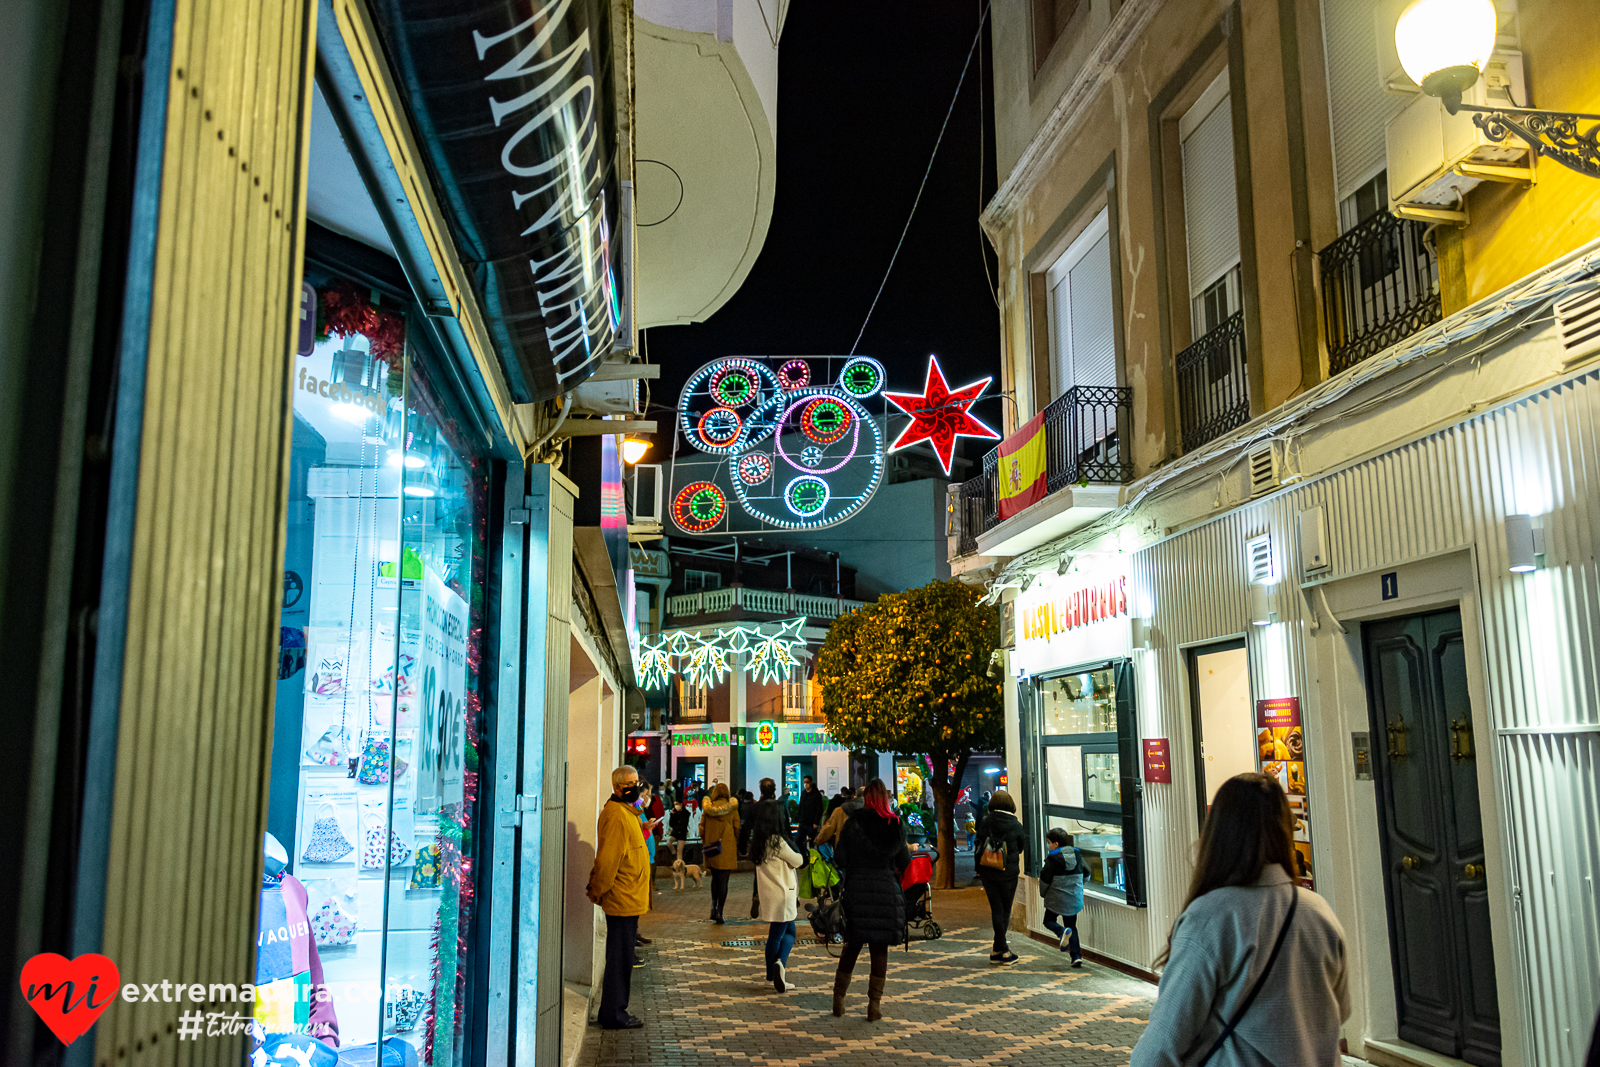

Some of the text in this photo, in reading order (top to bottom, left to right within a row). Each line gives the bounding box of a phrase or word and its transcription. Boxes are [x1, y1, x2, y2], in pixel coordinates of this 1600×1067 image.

[299, 367, 387, 417] facebook
[1386, 576, 1393, 597] 1
[421, 664, 461, 783] 19,90€
[672, 732, 729, 747] FARMACIA
